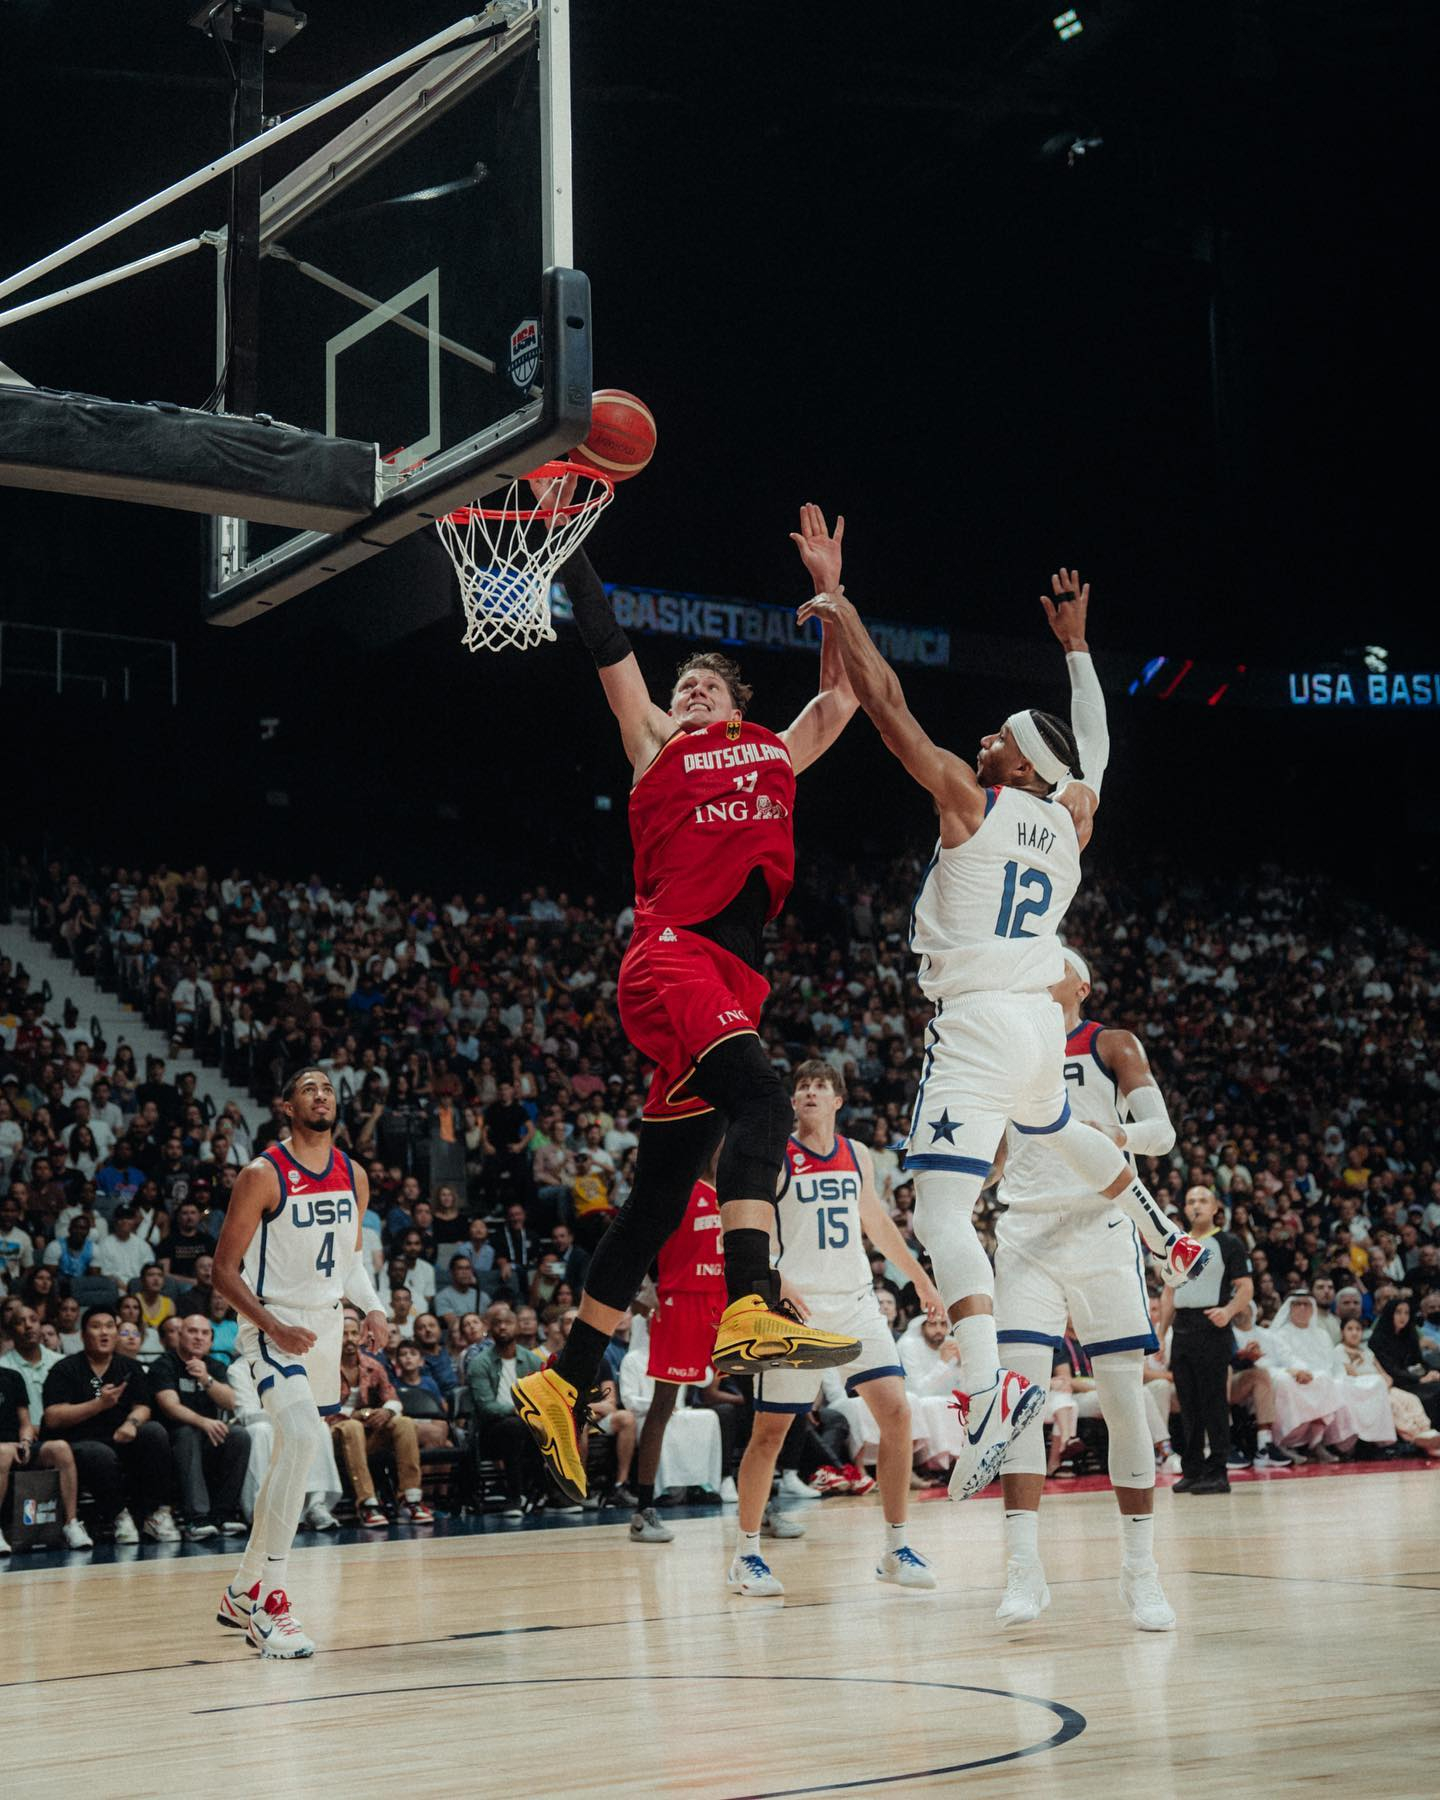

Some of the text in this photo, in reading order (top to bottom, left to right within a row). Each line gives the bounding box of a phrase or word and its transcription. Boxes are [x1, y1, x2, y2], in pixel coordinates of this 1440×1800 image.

[512, 324, 537, 356] USA
[614, 590, 821, 649] BASKETBALL
[1290, 673, 1440, 705] USA BAS
[684, 743, 792, 773] DEUTSCHLAN
[695, 800, 749, 824] ING
[1017, 822, 1056, 855] HART
[994, 859, 1053, 939] 12
[717, 1009, 749, 1026] ING
[795, 1178, 857, 1204] USA
[292, 1198, 352, 1229] USA
[816, 1207, 850, 1250] 15
[315, 1231, 335, 1278] 4
[695, 1263, 722, 1276] ING
[667, 1367, 687, 1377] ING
